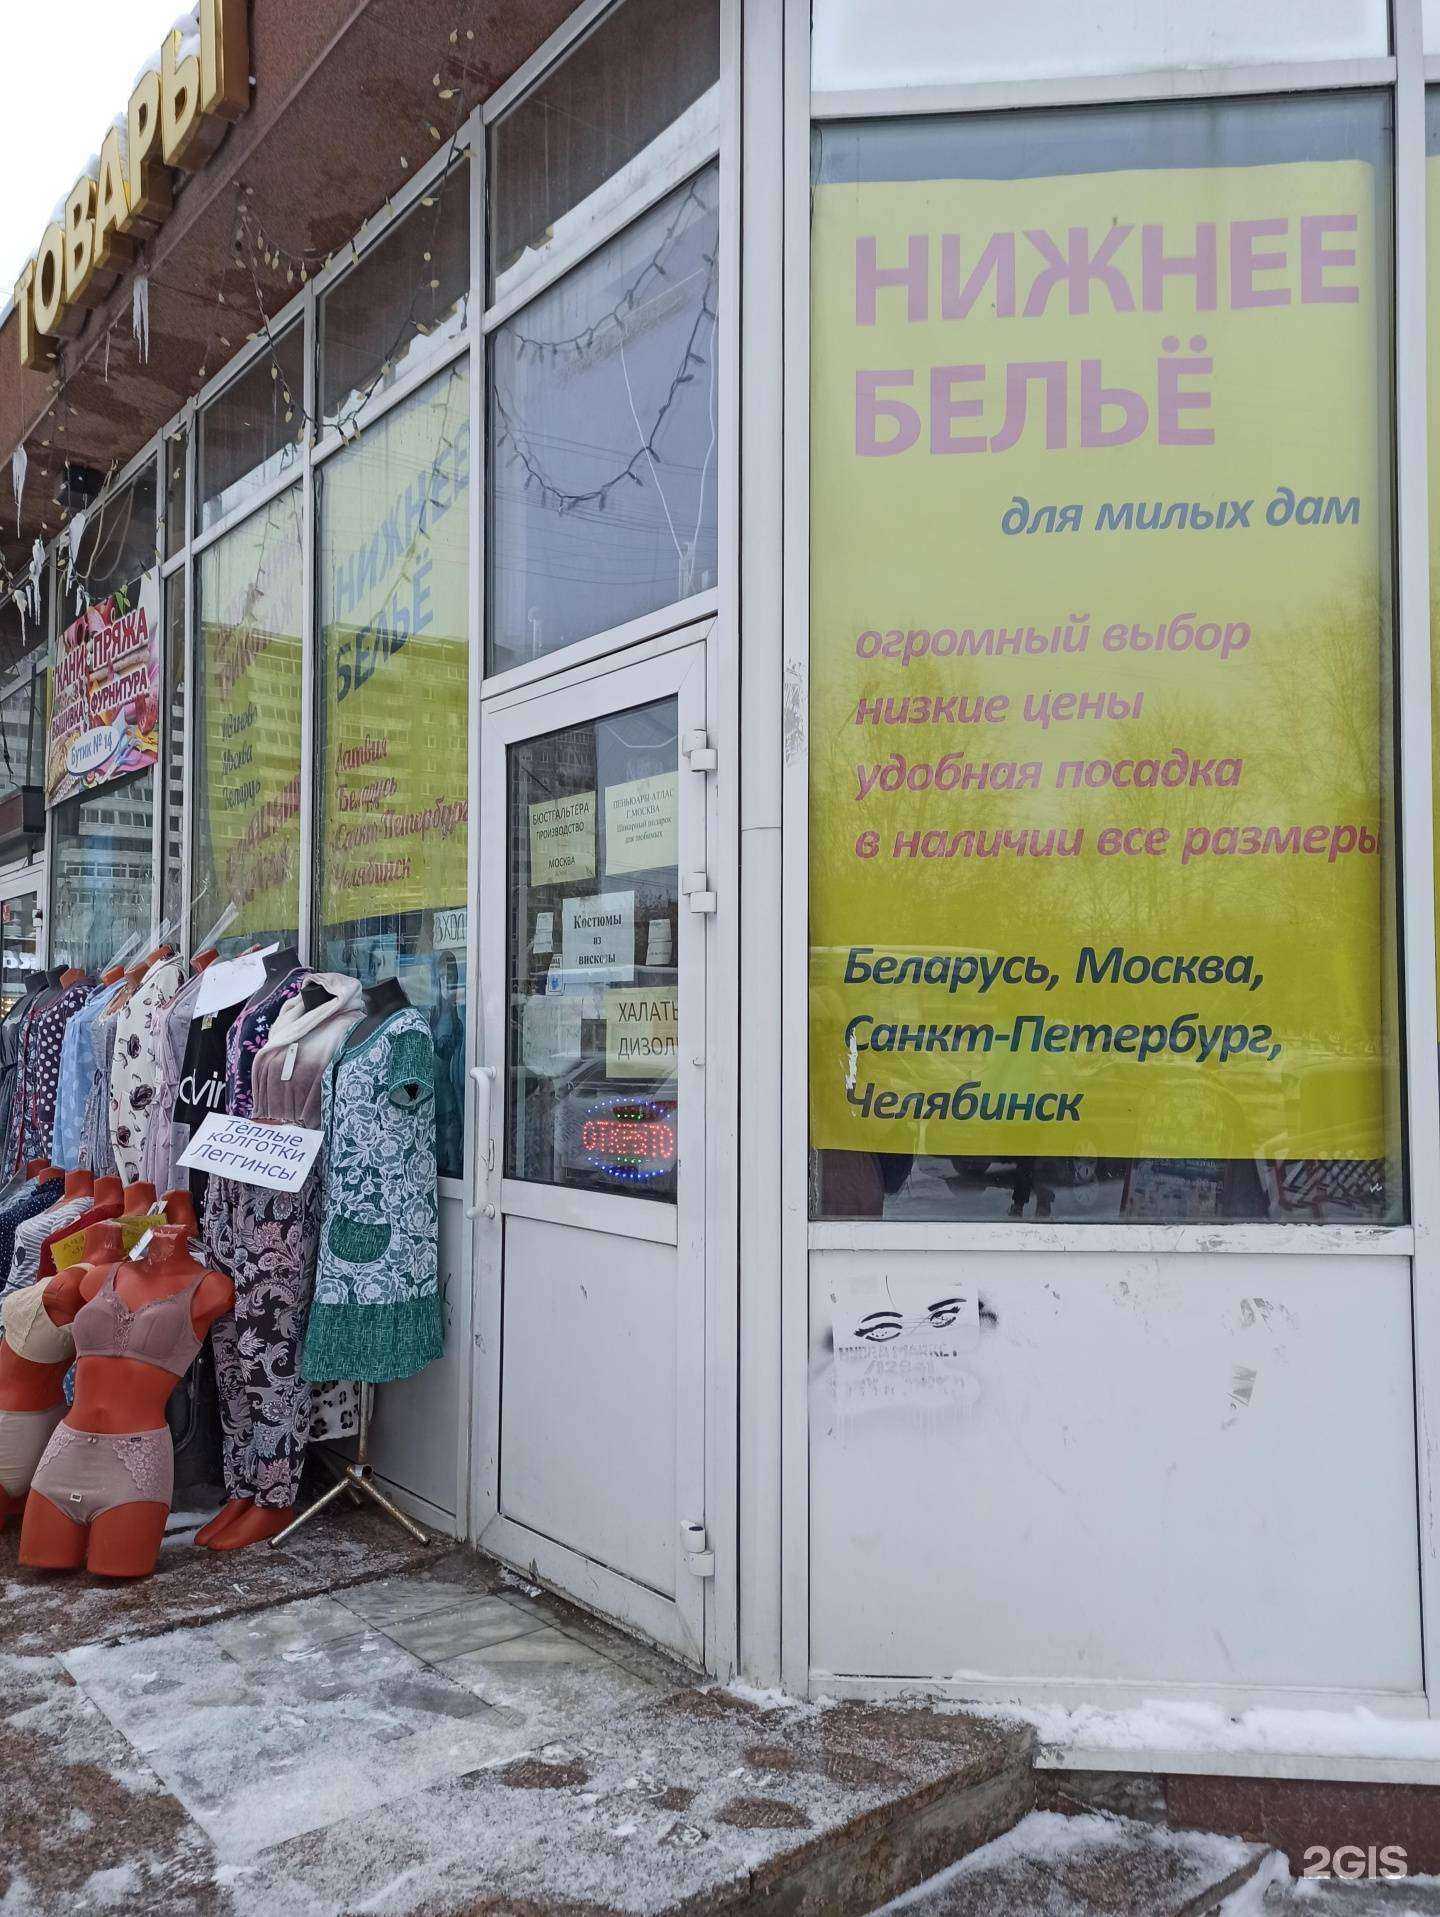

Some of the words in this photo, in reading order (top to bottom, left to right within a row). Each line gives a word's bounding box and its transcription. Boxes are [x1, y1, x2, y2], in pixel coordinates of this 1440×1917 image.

[13, 0, 226, 366] ТОВАРЫ
[855, 214, 1360, 326] НИЖНЕЕ
[855, 334, 1216, 458] БЕЛЬЁ
[1001, 496, 1083, 535] для
[1095, 499, 1254, 530] милых
[1266, 486, 1361, 526] дам
[93, 606, 148, 669] ПРЯЖА
[856, 613, 1090, 665] огромный
[1103, 613, 1252, 660] выбор
[90, 668, 147, 713] ФУРНИТУРА
[855, 694, 1009, 726] низкие
[1024, 691, 1145, 729] цены
[856, 752, 1044, 800] удобная
[1056, 748, 1244, 789] посадка
[532, 802, 590, 825] БЮСТГАЛЬТЕРА
[536, 821, 585, 841] ПРОИЗВОДСТВО
[549, 856, 576, 869] МОСКВА
[856, 830, 880, 859] в
[893, 826, 1084, 859] наличии
[1097, 826, 1168, 857] все
[1182, 823, 1382, 864] размеры
[573, 914, 622, 929] Костюмы
[593, 936, 602, 945] из
[844, 948, 1060, 993] Беларусь,
[1075, 948, 1265, 991] Москва,
[617, 1037, 678, 1060] ДИЗОЛ
[844, 1013, 1283, 1062] Санкт-Петербург,
[846, 1081, 1083, 1122] Челябинск
[191, 1144, 297, 1180] Леггинсы
[207, 1131, 306, 1162] колготки
